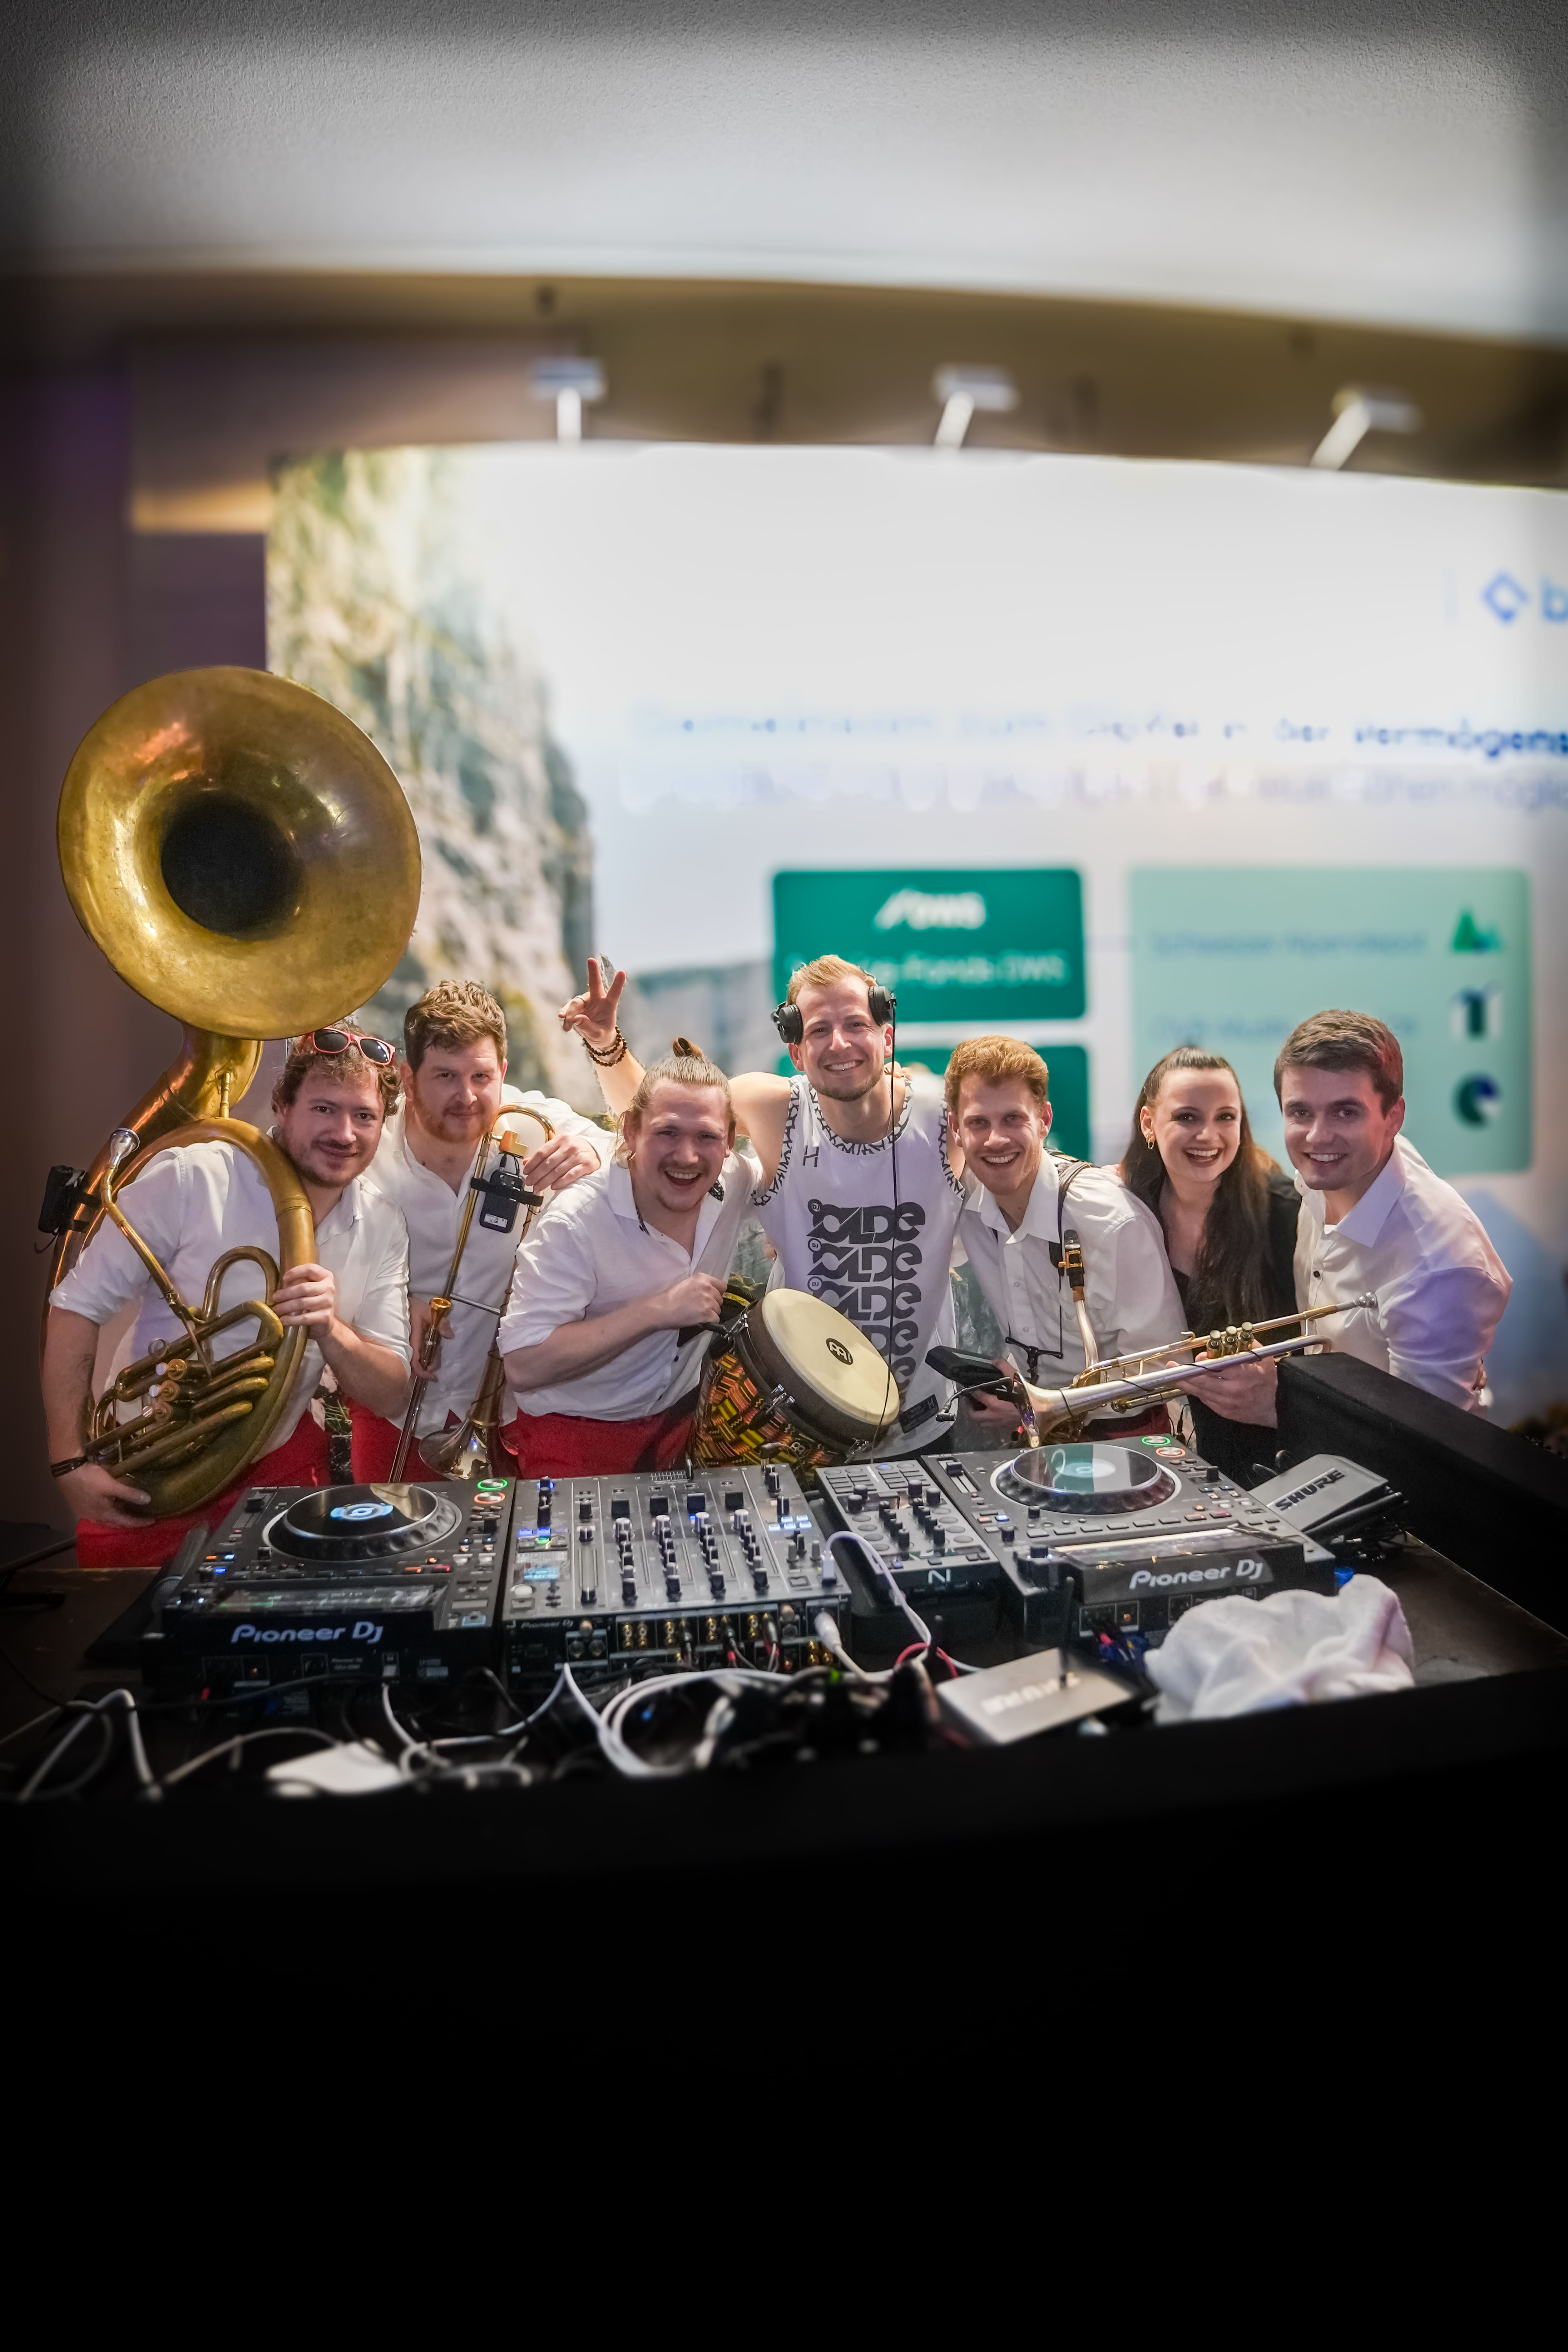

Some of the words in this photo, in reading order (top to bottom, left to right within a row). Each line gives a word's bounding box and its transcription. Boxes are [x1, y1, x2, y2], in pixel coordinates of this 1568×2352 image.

[1275, 1469, 1345, 1511] SHURE
[1129, 1566, 1230, 1590] Pioneer
[1236, 1559, 1263, 1580] DJ
[231, 1624, 346, 1644] Pioneer
[351, 1621, 384, 1644] DJ
